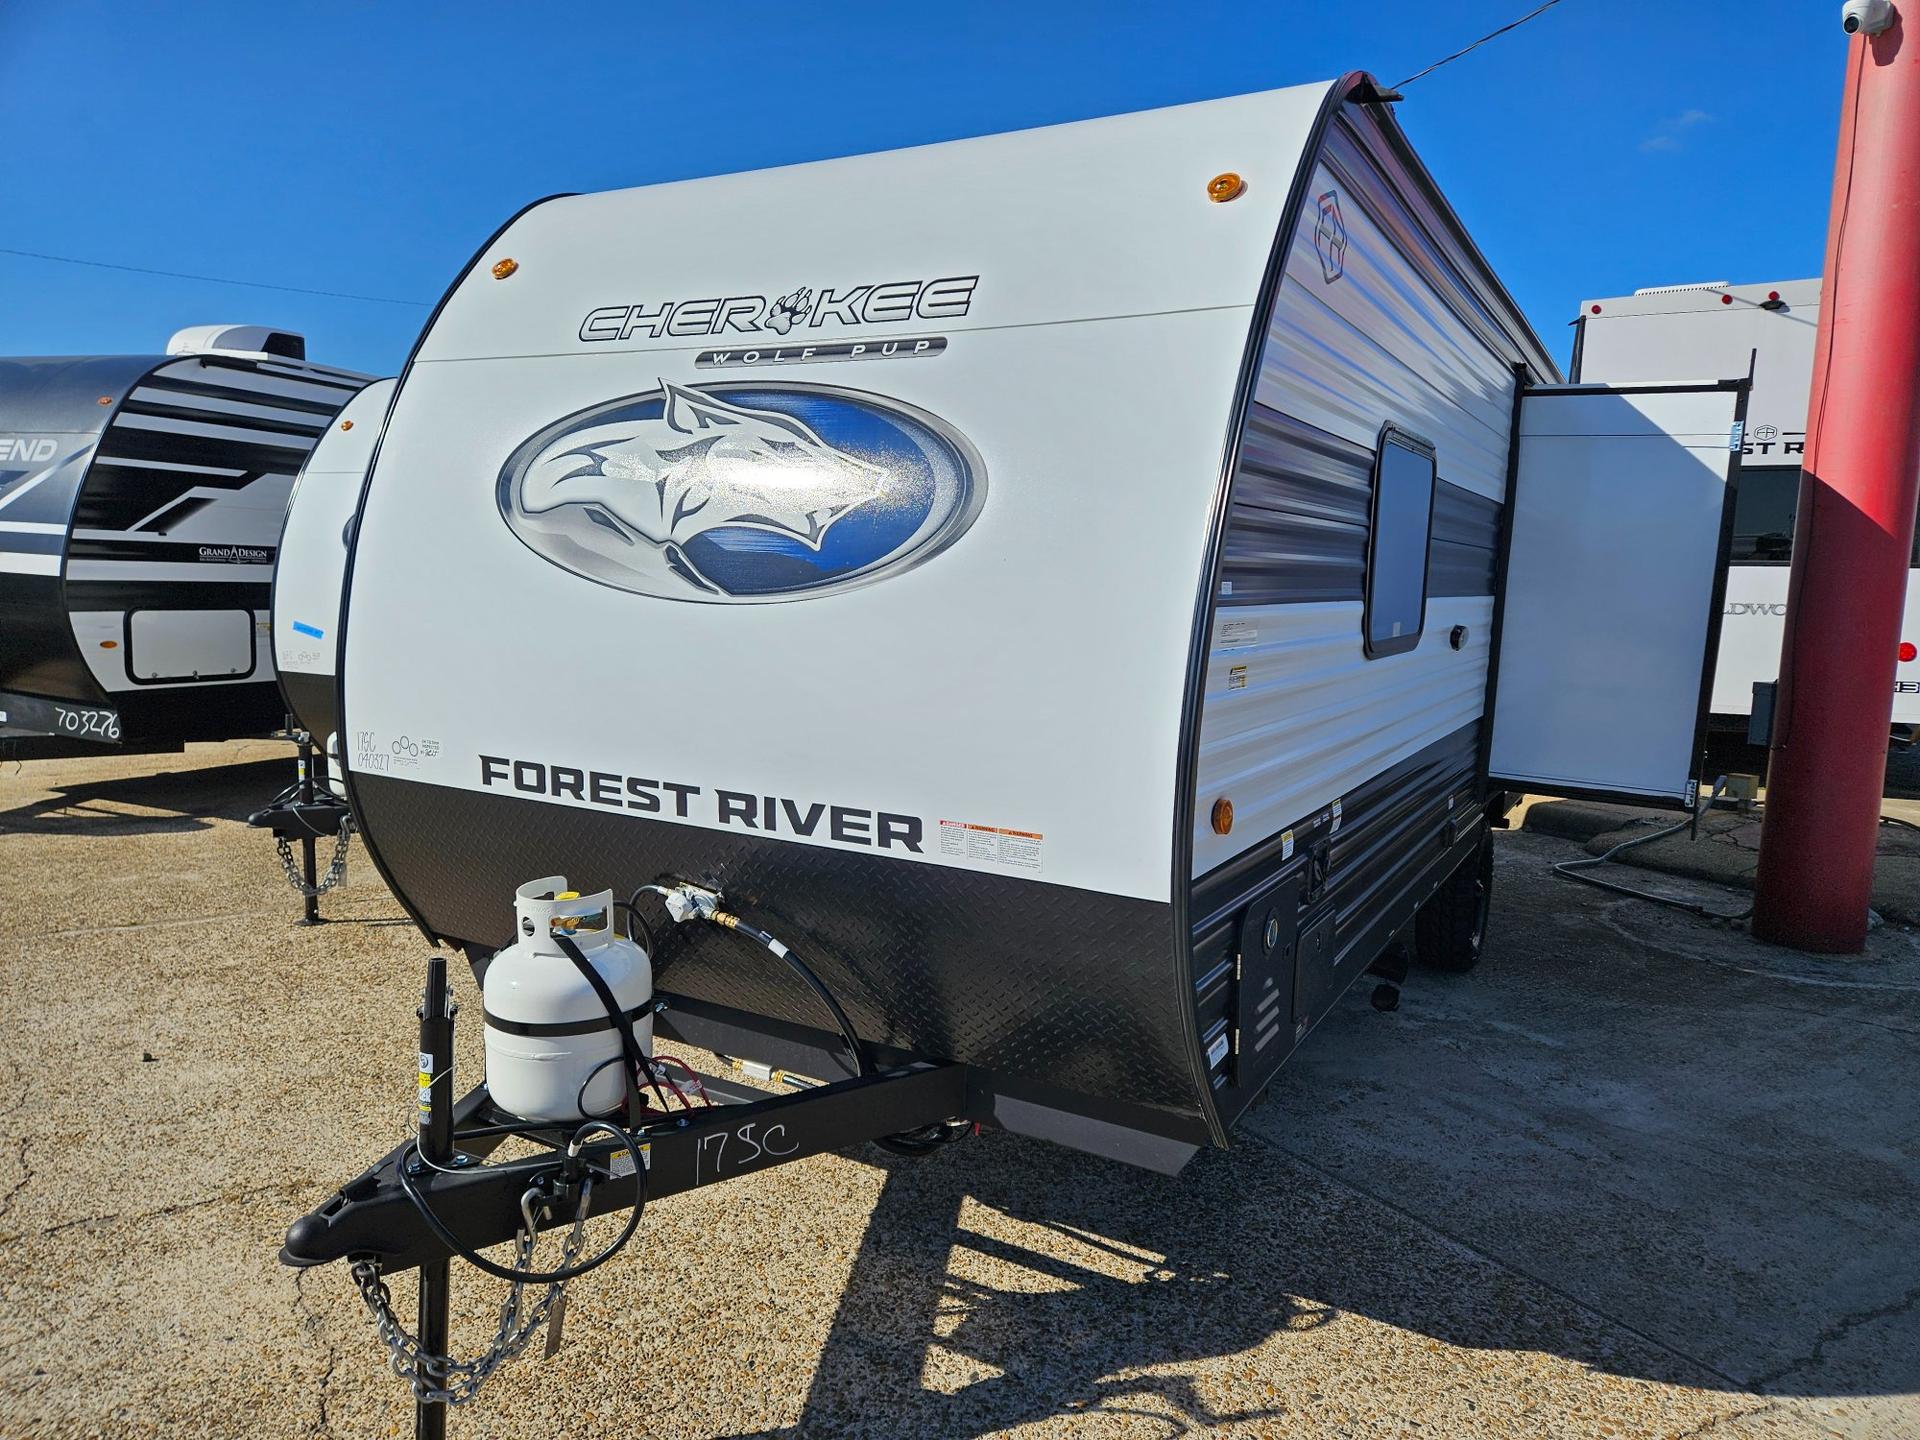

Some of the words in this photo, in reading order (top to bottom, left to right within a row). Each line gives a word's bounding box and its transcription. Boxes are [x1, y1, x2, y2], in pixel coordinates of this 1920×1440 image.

[711, 347, 817, 365] WOLF
[850, 340, 930, 358] PUP
[199, 546, 231, 557] GRAND
[238, 548, 267, 557] DESIGN
[55, 706, 120, 739] 703276
[357, 752, 390, 772] 040327
[477, 753, 701, 818] FOREST
[713, 788, 925, 854] RIVER
